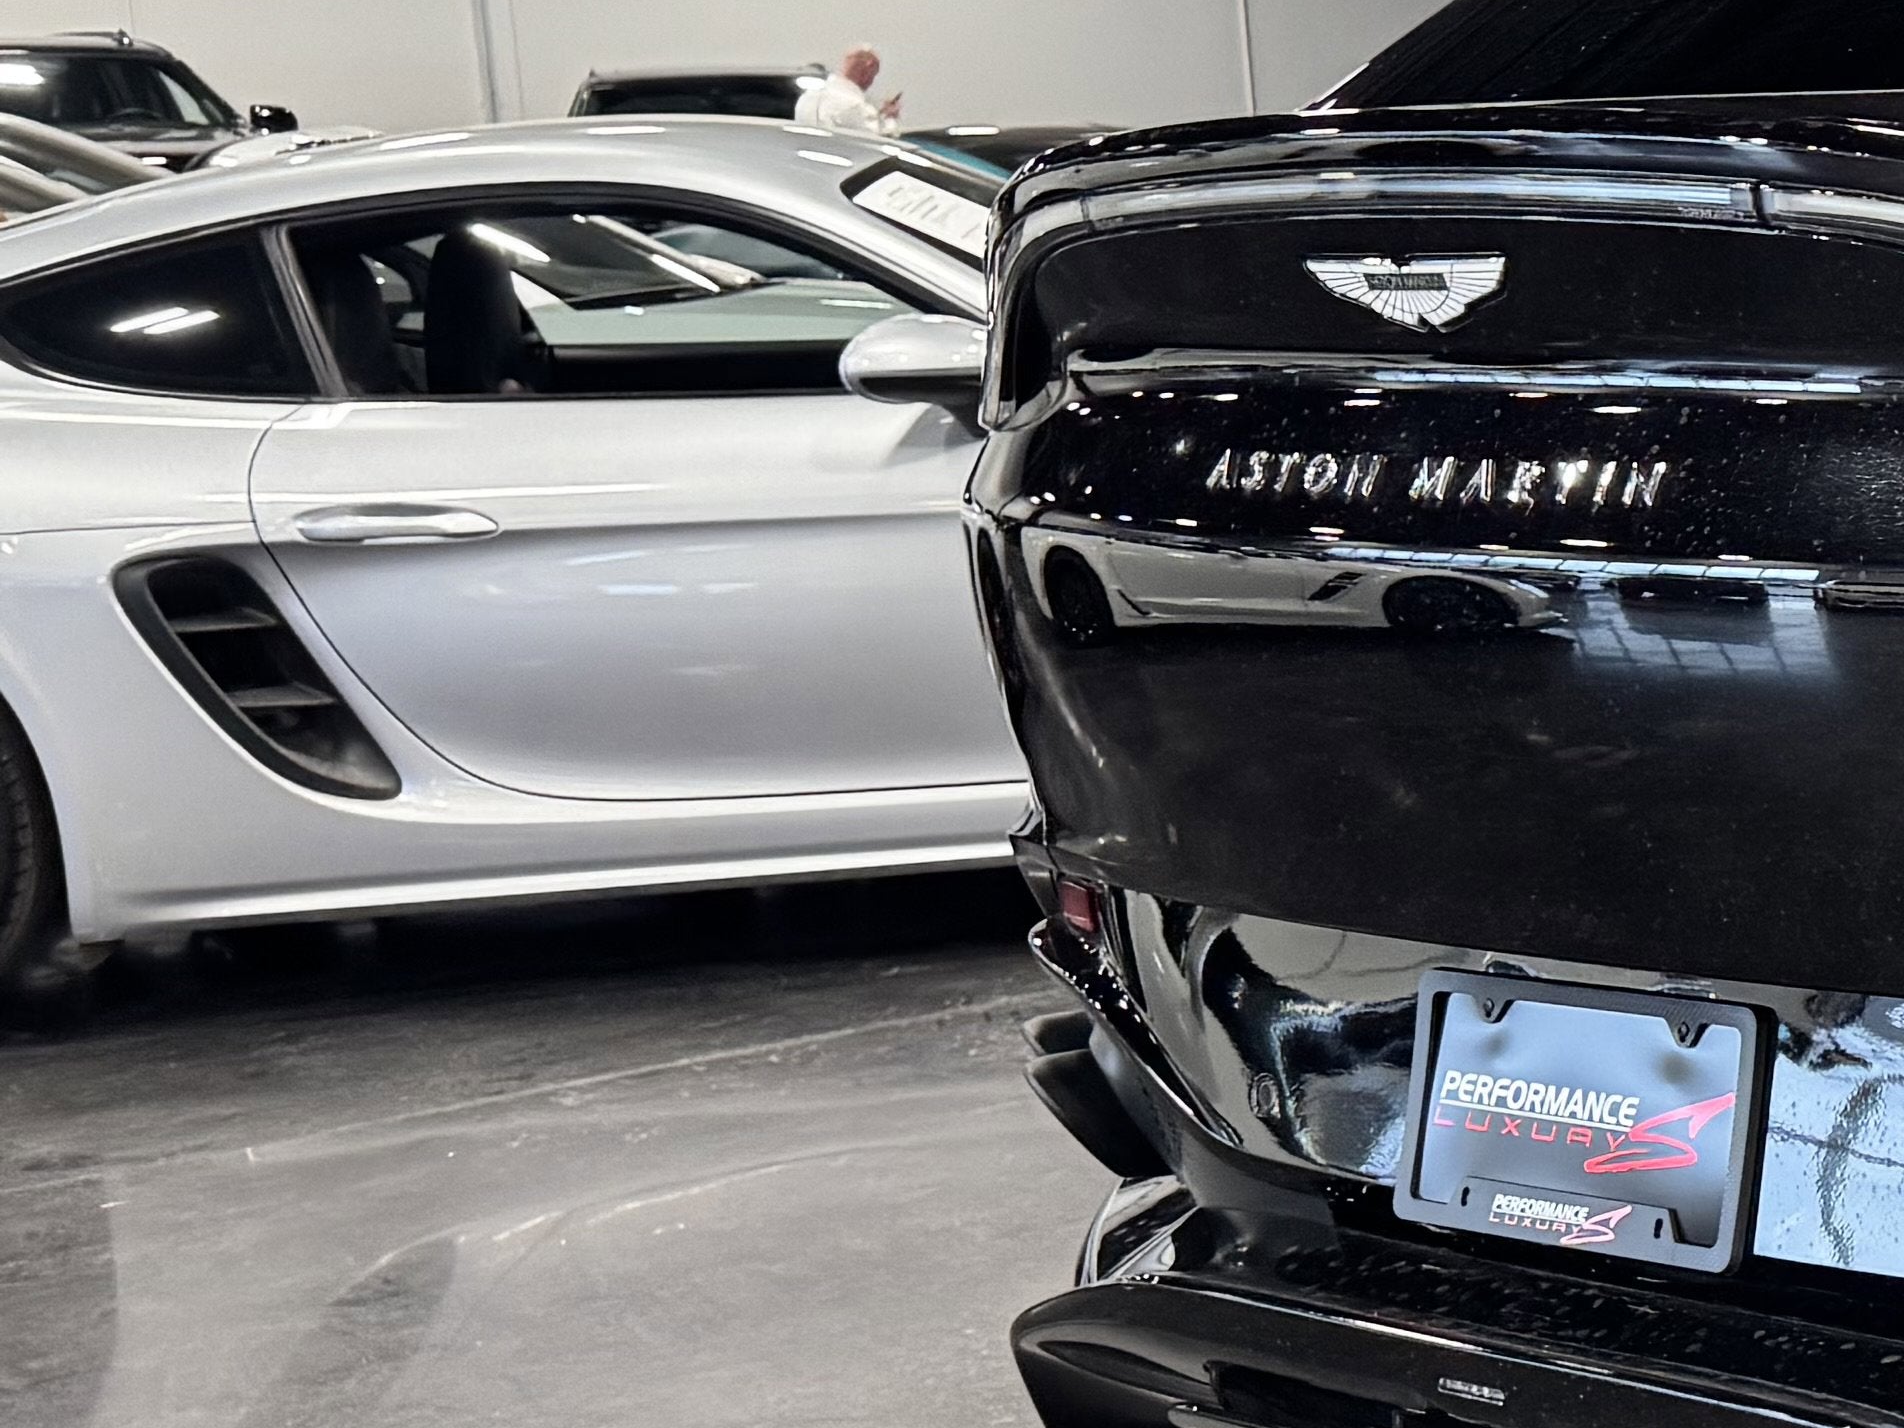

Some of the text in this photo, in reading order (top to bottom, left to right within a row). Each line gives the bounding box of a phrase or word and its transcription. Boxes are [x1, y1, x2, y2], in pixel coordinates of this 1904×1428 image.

[1205, 447, 1668, 510] ASTON MARTIN
[1440, 1070, 1641, 1127] PERFORMANCE
[1492, 1192, 1590, 1223] PERFORMANCE
